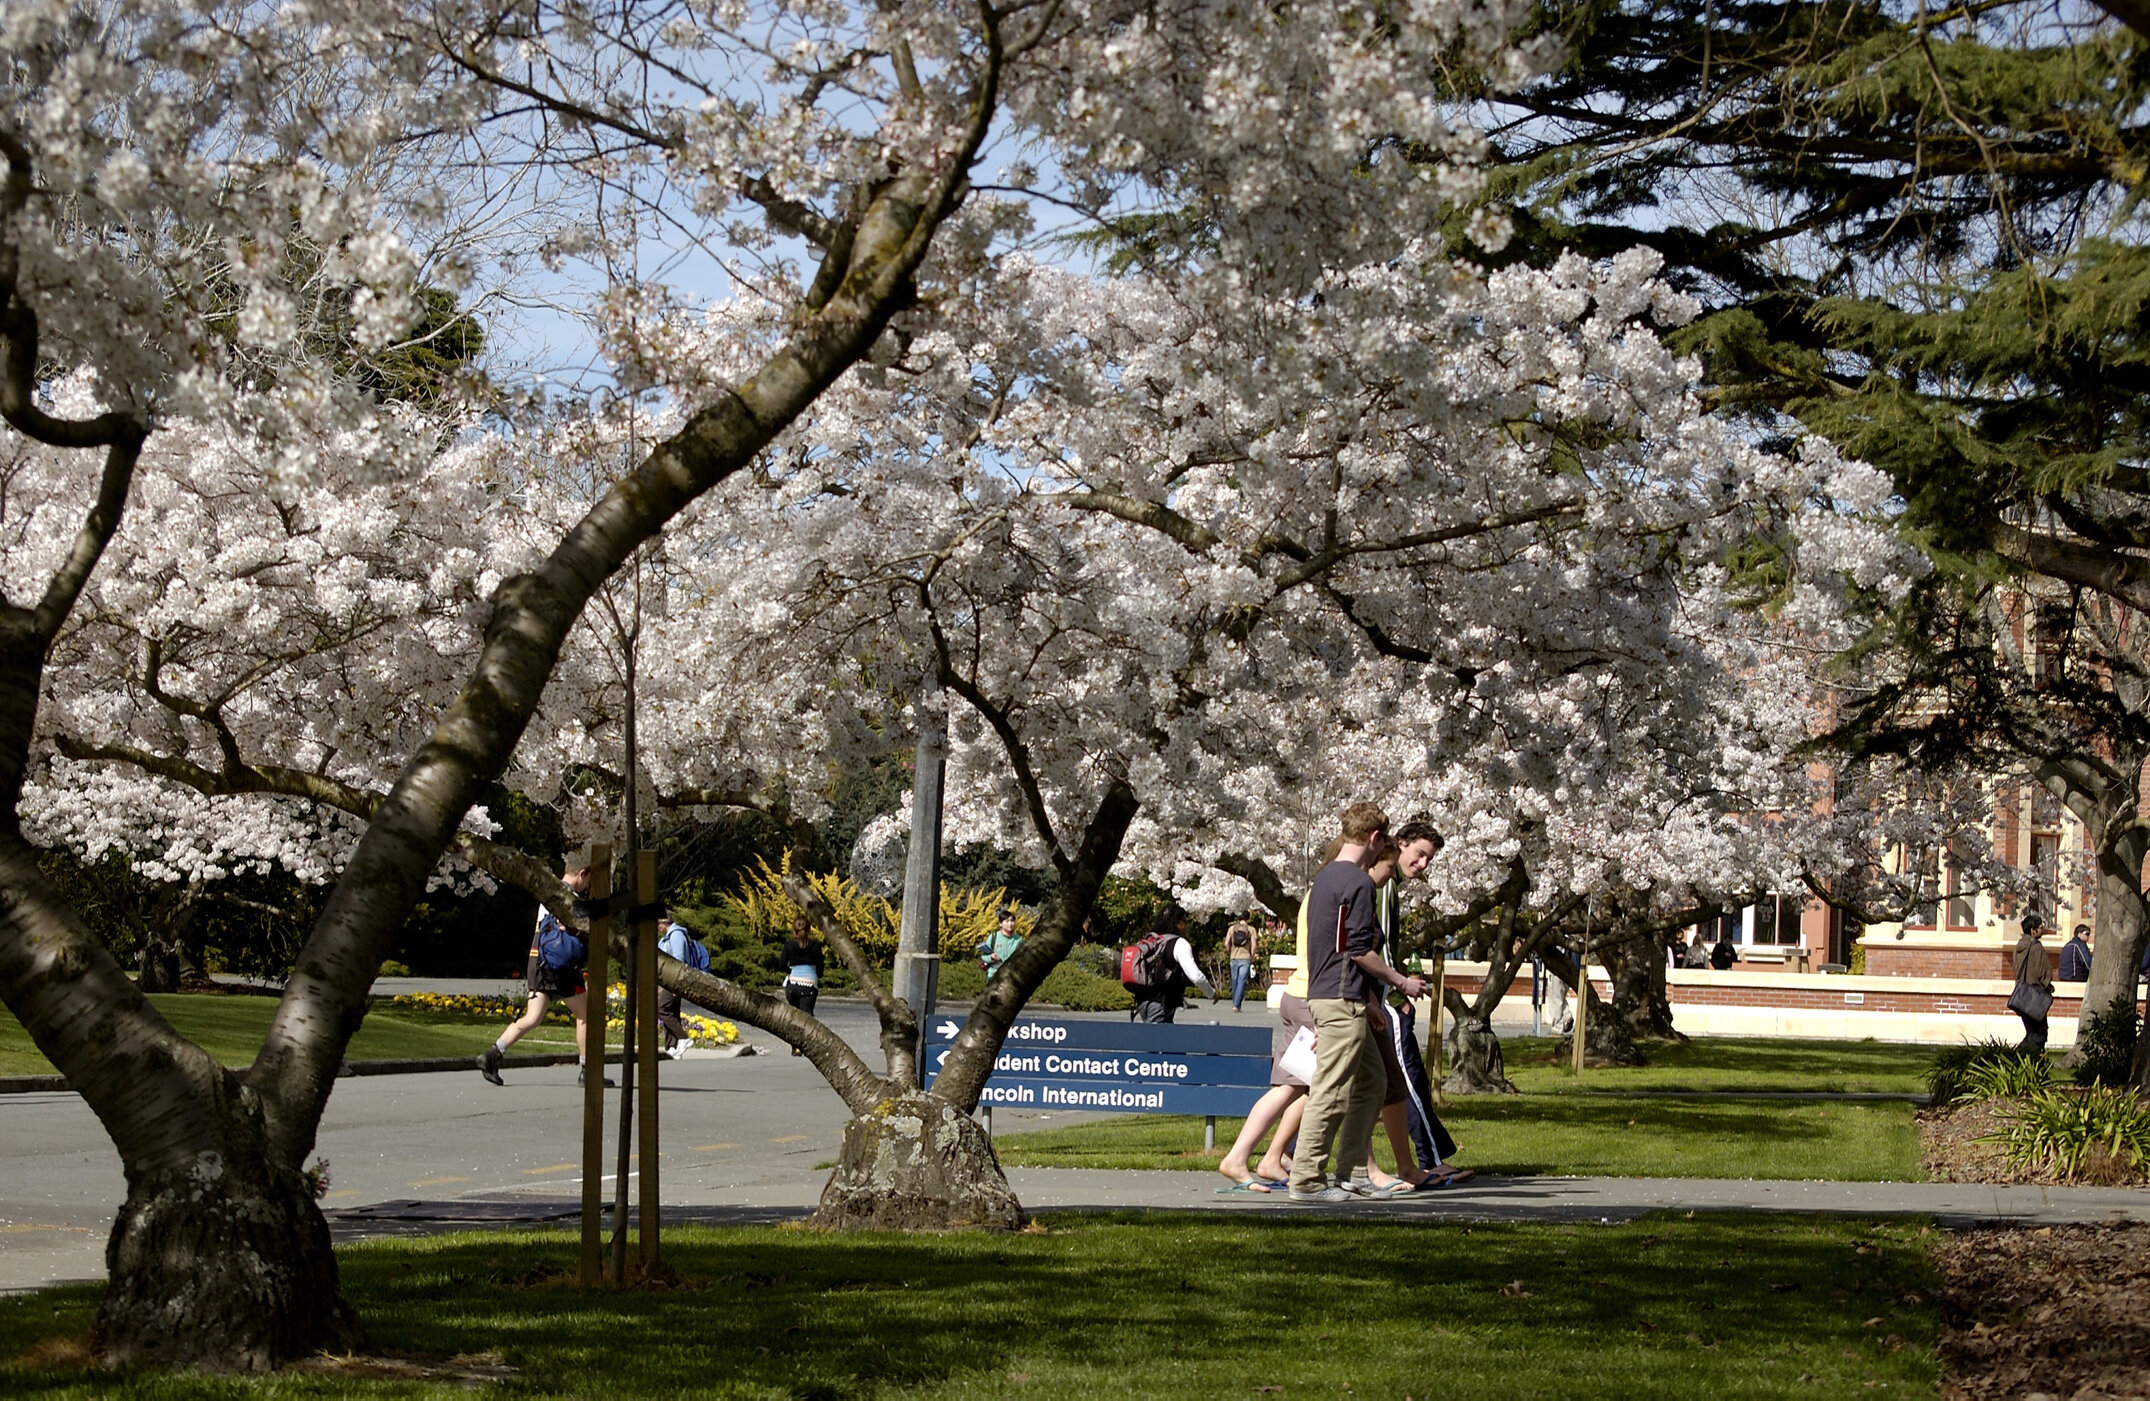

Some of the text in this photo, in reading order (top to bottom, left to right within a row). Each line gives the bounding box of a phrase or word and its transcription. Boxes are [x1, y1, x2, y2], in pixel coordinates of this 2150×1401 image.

[1007, 1022, 1067, 1043] kshop
[994, 1053, 1189, 1078] dent Contact Centre
[979, 1085, 1164, 1108] ncoln International
